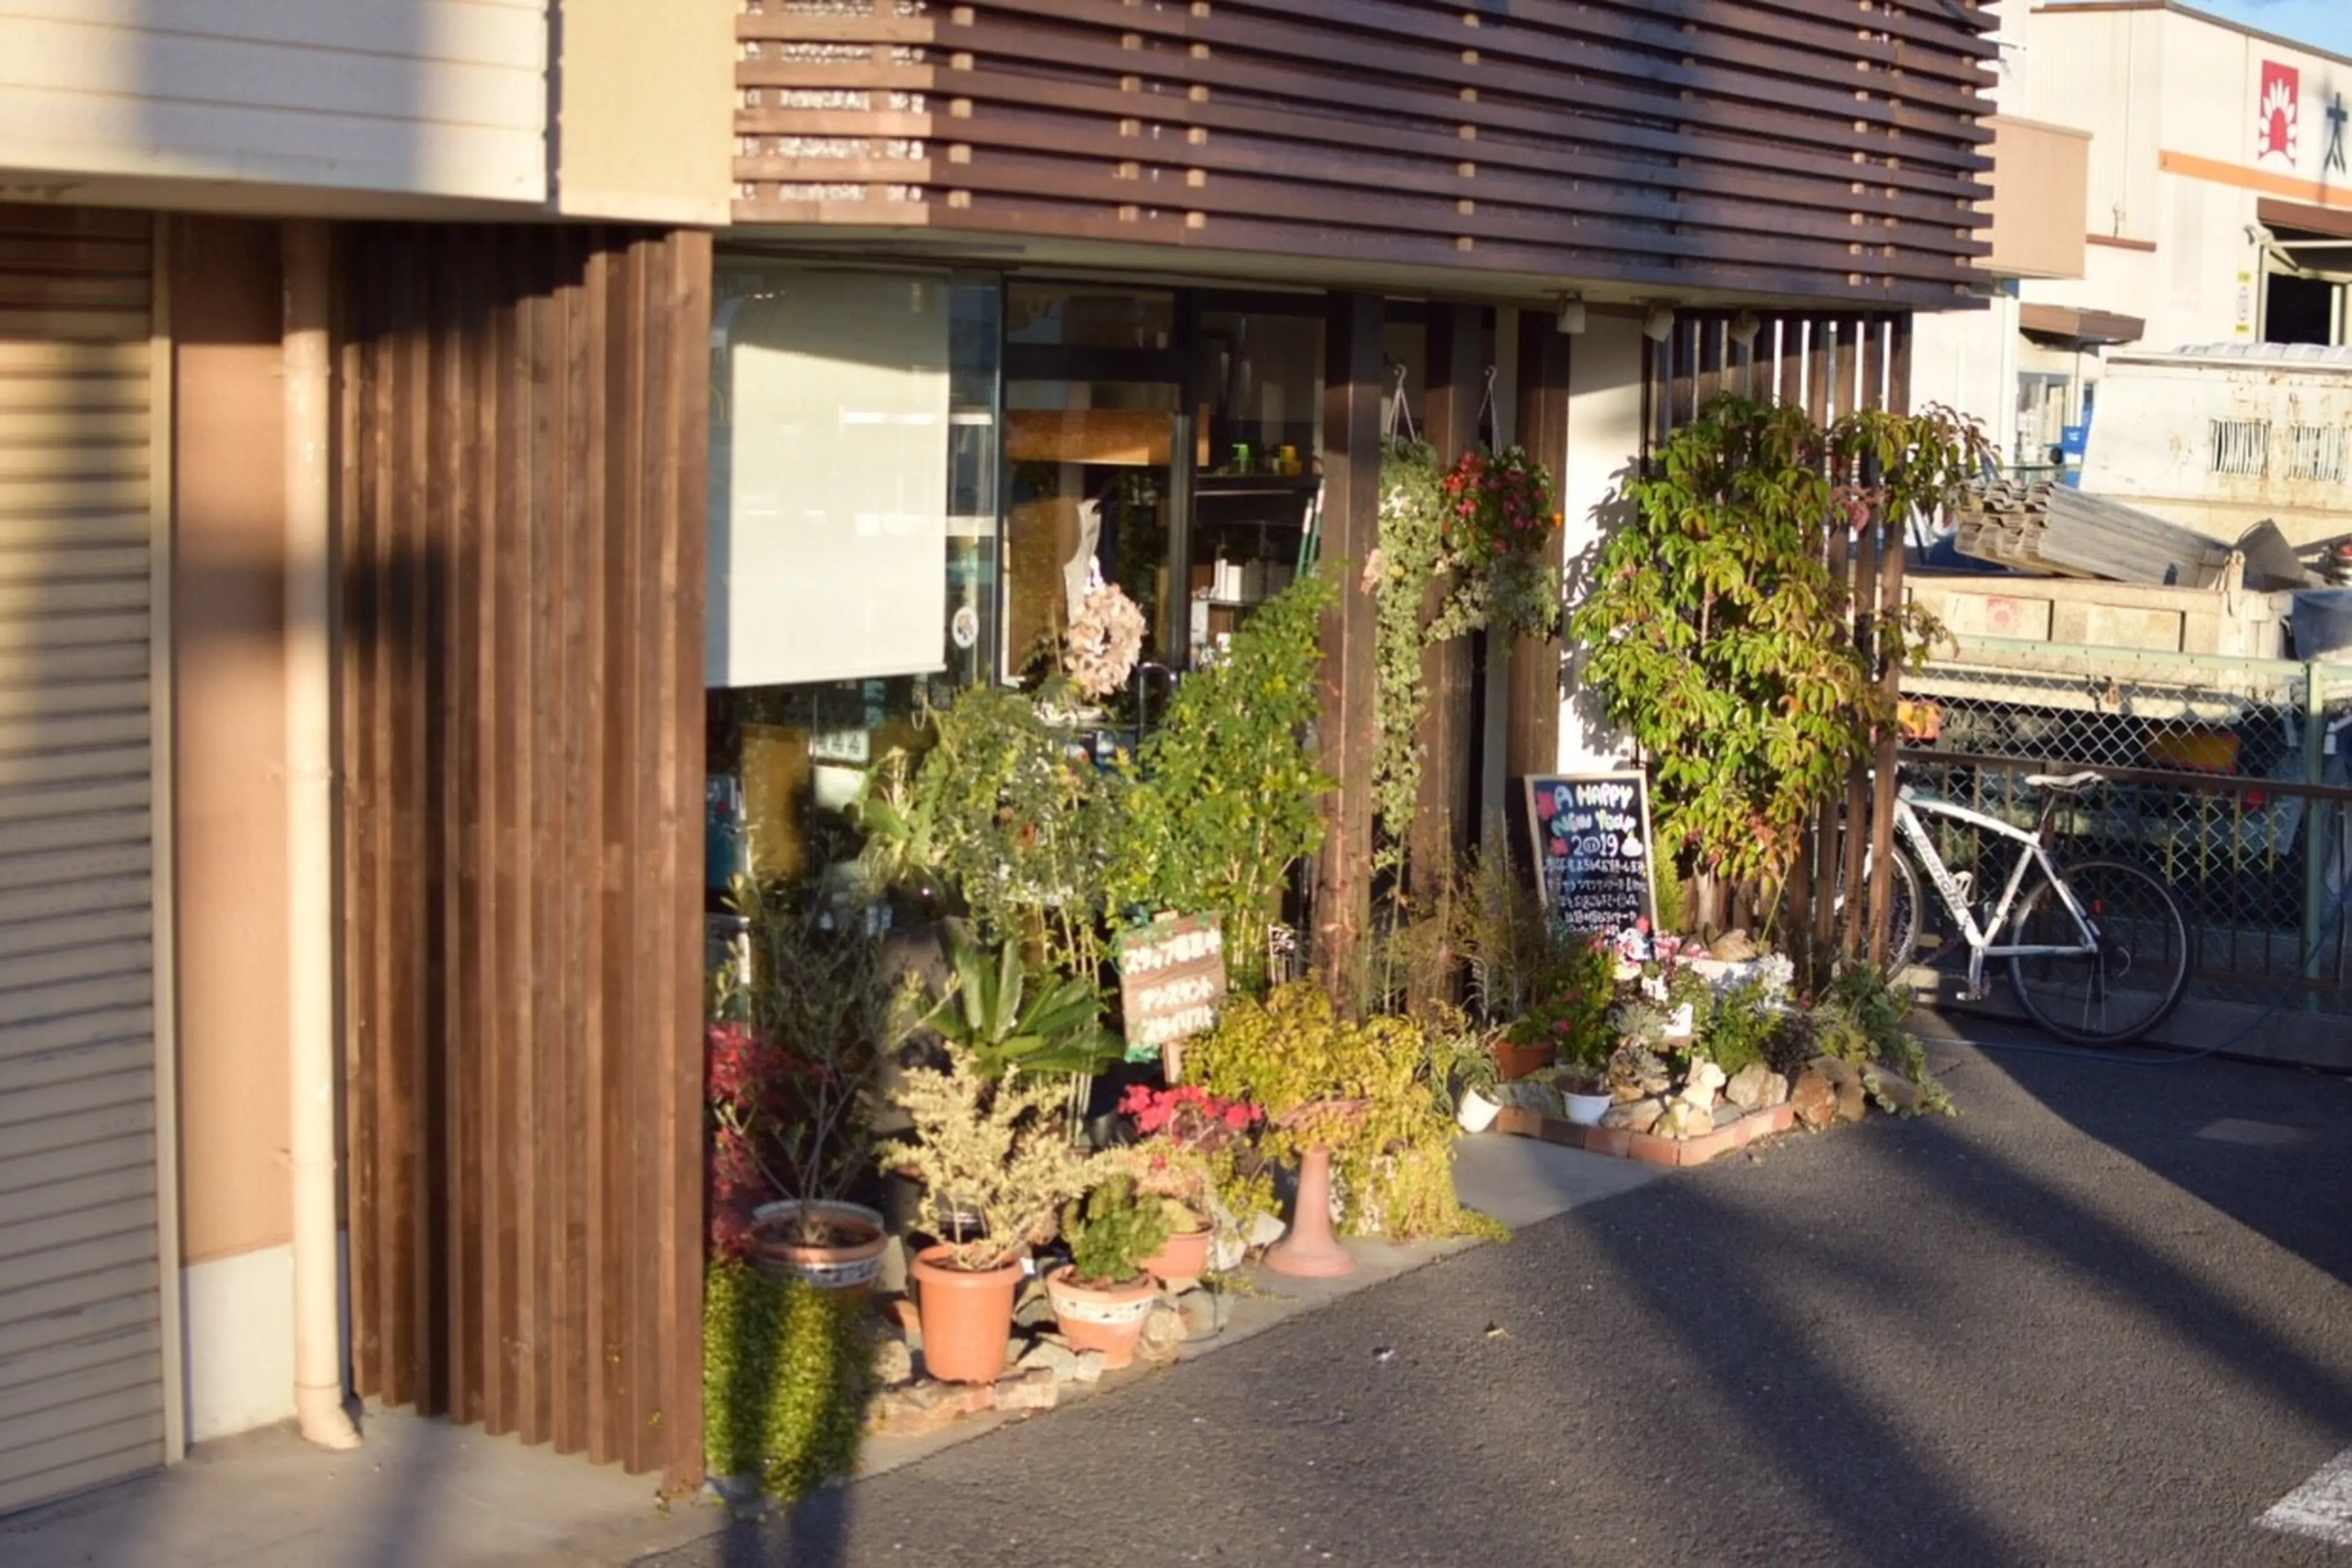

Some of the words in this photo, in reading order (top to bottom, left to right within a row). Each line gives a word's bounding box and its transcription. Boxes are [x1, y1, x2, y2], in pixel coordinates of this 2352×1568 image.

[1553, 785, 1573, 809] A
[1575, 782, 1634, 809] HAPPY
[1572, 834, 1619, 857] 2019
[1139, 976, 1214, 1011] アシスタント
